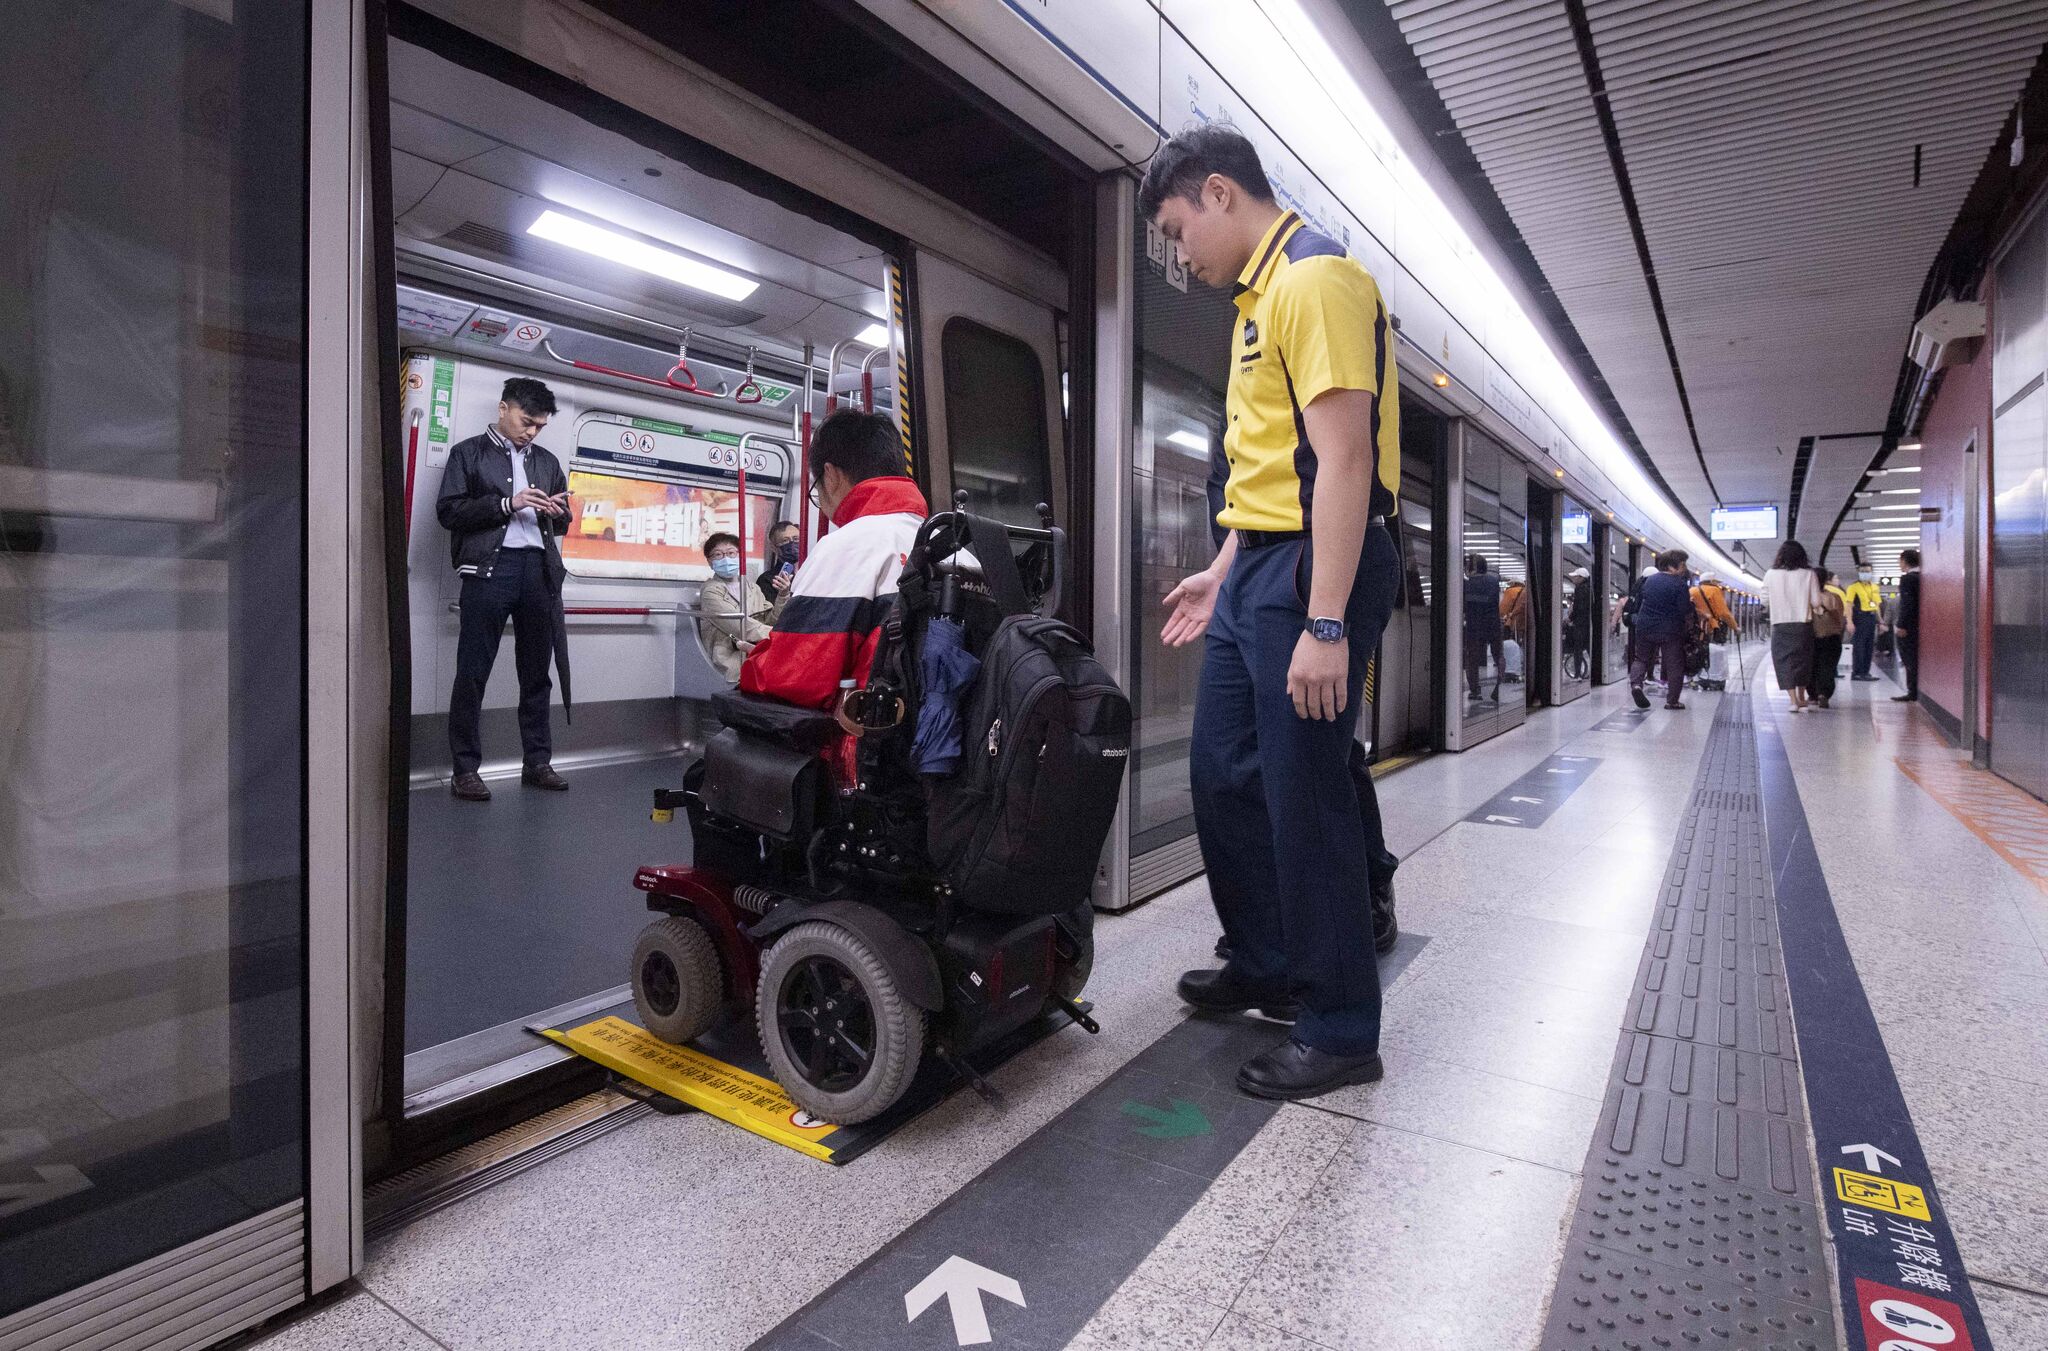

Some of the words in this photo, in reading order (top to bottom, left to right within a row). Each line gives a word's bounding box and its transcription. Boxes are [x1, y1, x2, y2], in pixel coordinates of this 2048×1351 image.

[1149, 229, 1163, 261] 1-3
[705, 1064, 733, 1077] priority
[731, 1075, 755, 1087] giving
[1842, 1207, 1879, 1236] Lift
[1885, 1215, 1951, 1292] 升降機
